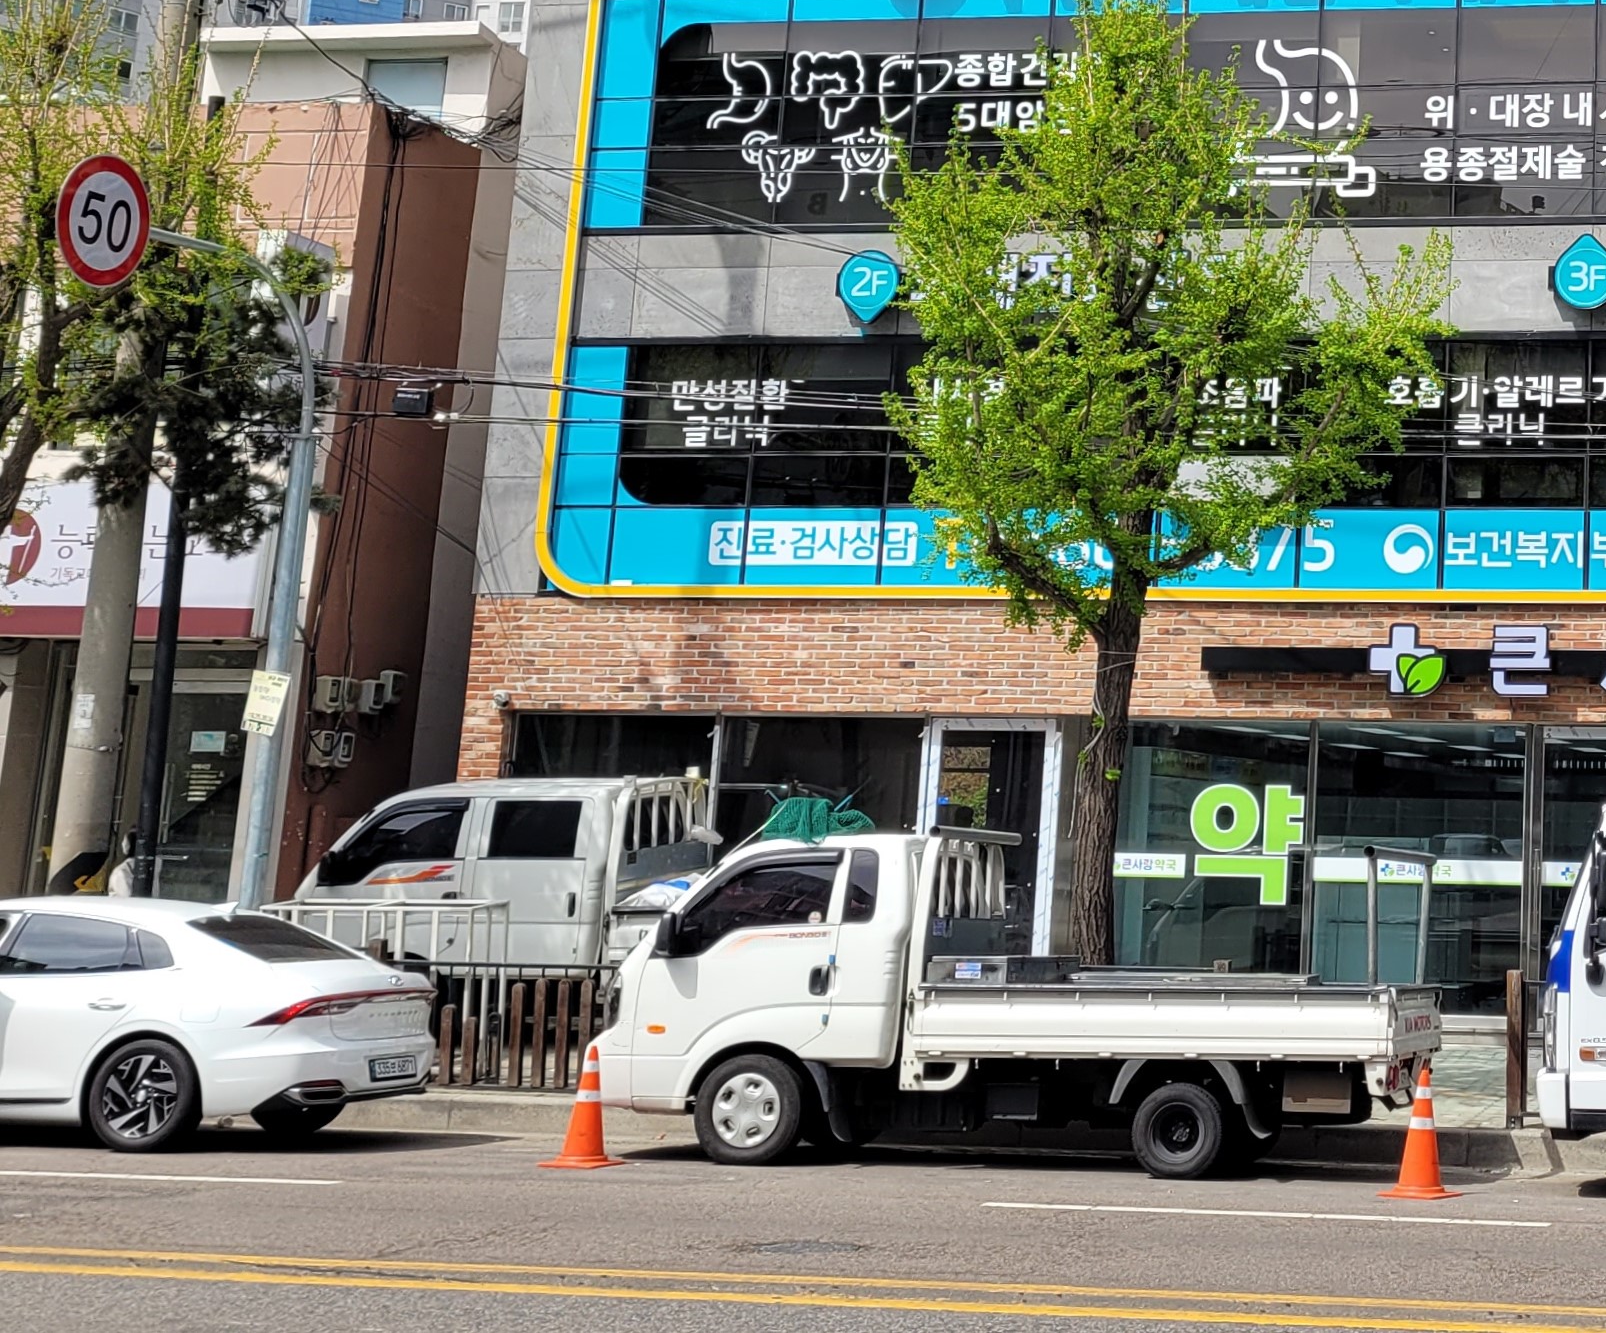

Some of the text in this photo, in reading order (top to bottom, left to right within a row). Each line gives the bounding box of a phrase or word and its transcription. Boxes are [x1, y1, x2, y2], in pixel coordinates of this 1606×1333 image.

[1419, 147, 1588, 182] 용종절제술
[77, 191, 132, 253] 50
[850, 266, 888, 297] 2F
[1568, 261, 1606, 292] 3F
[1190, 783, 1305, 907] 약
